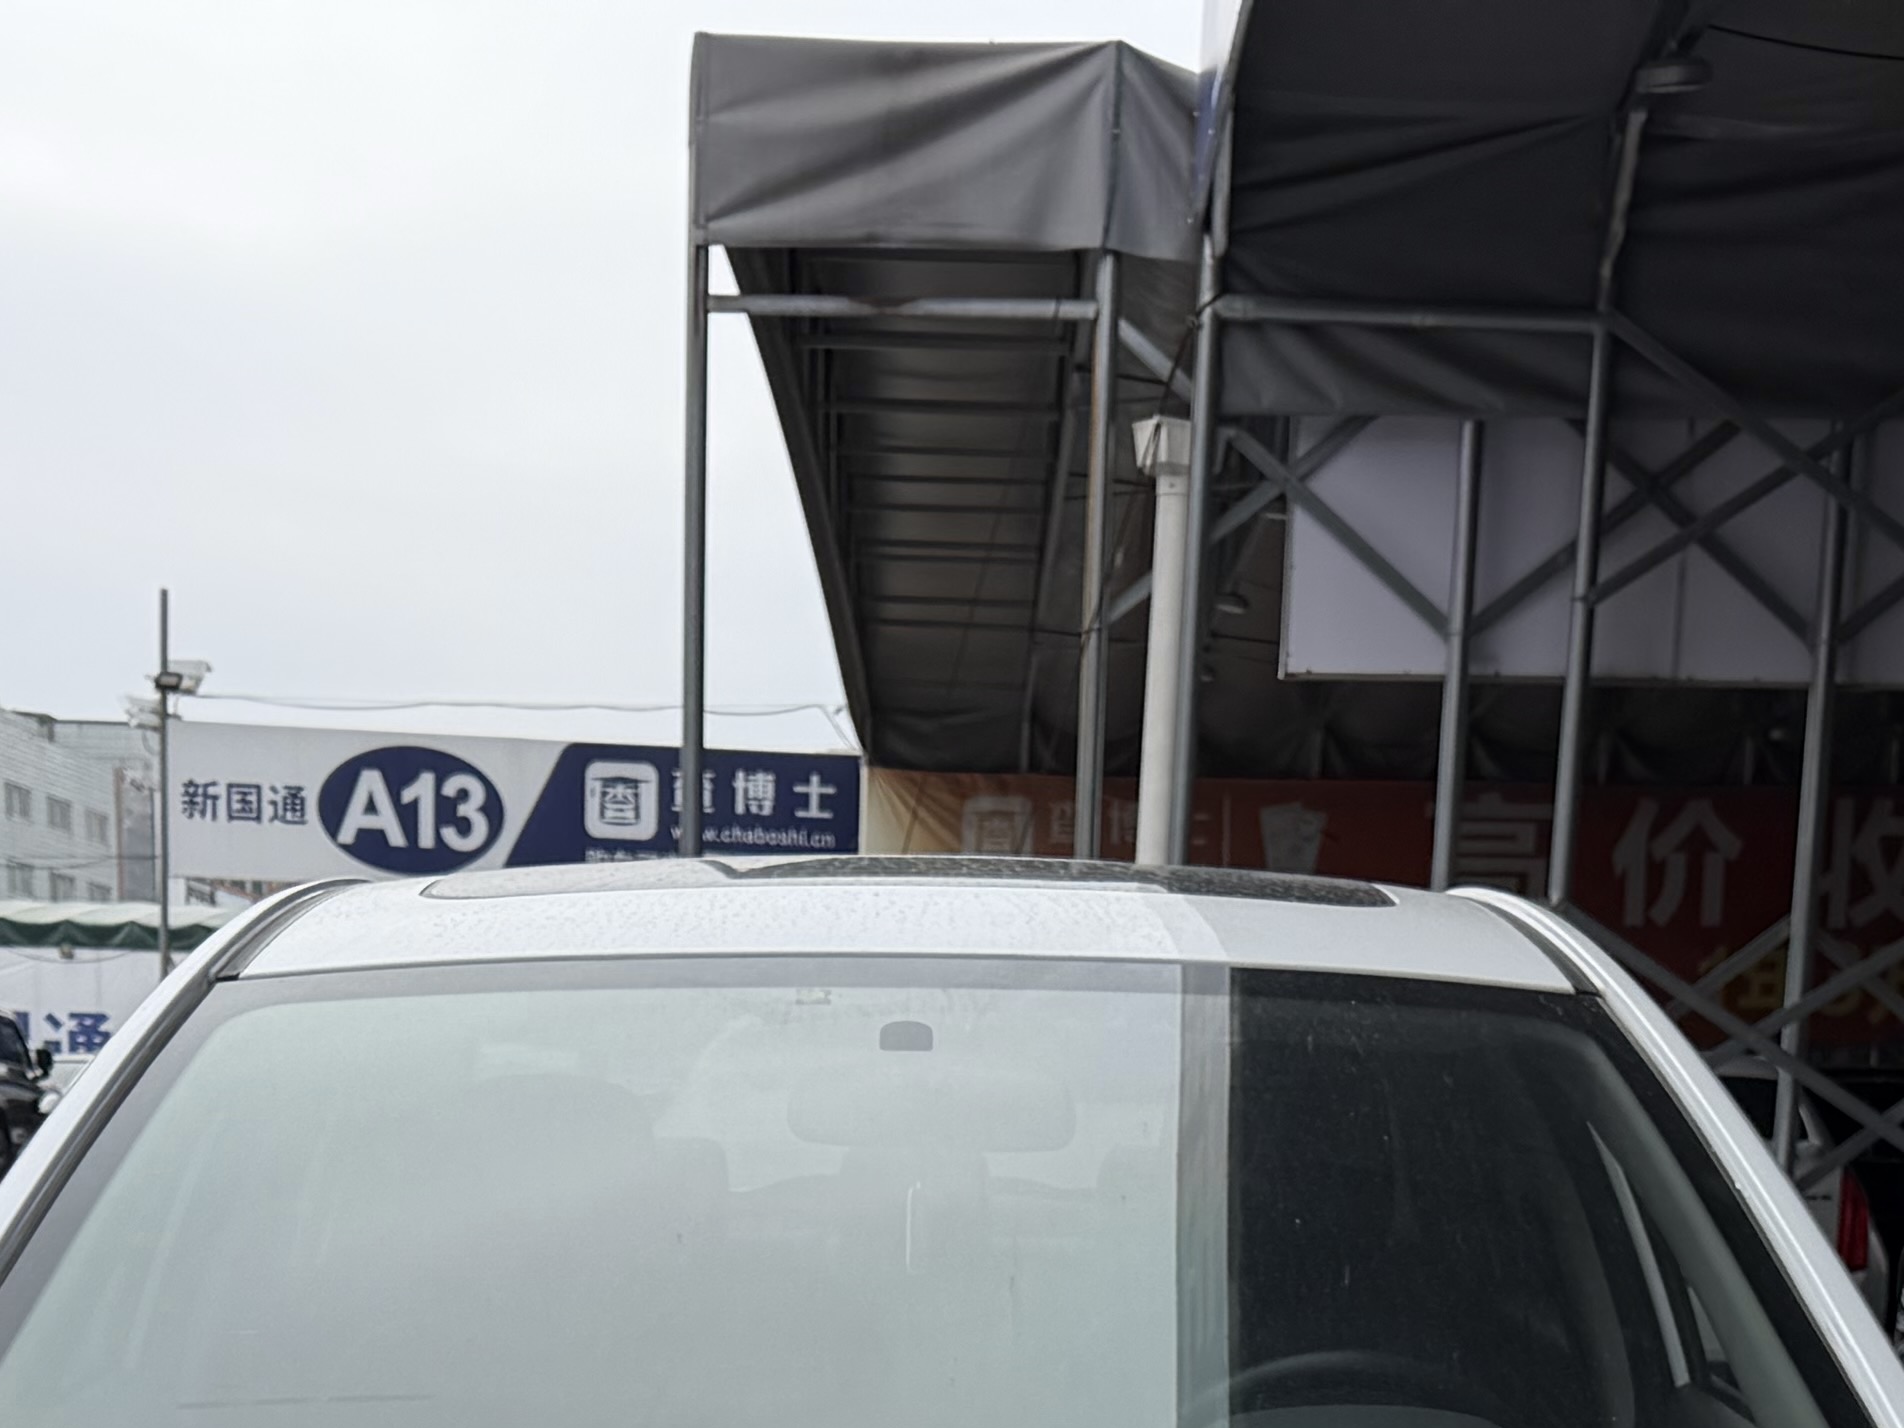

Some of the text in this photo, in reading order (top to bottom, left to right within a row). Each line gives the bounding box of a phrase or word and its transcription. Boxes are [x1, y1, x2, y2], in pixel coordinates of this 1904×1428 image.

[180, 767, 492, 853] 新国通 A13
